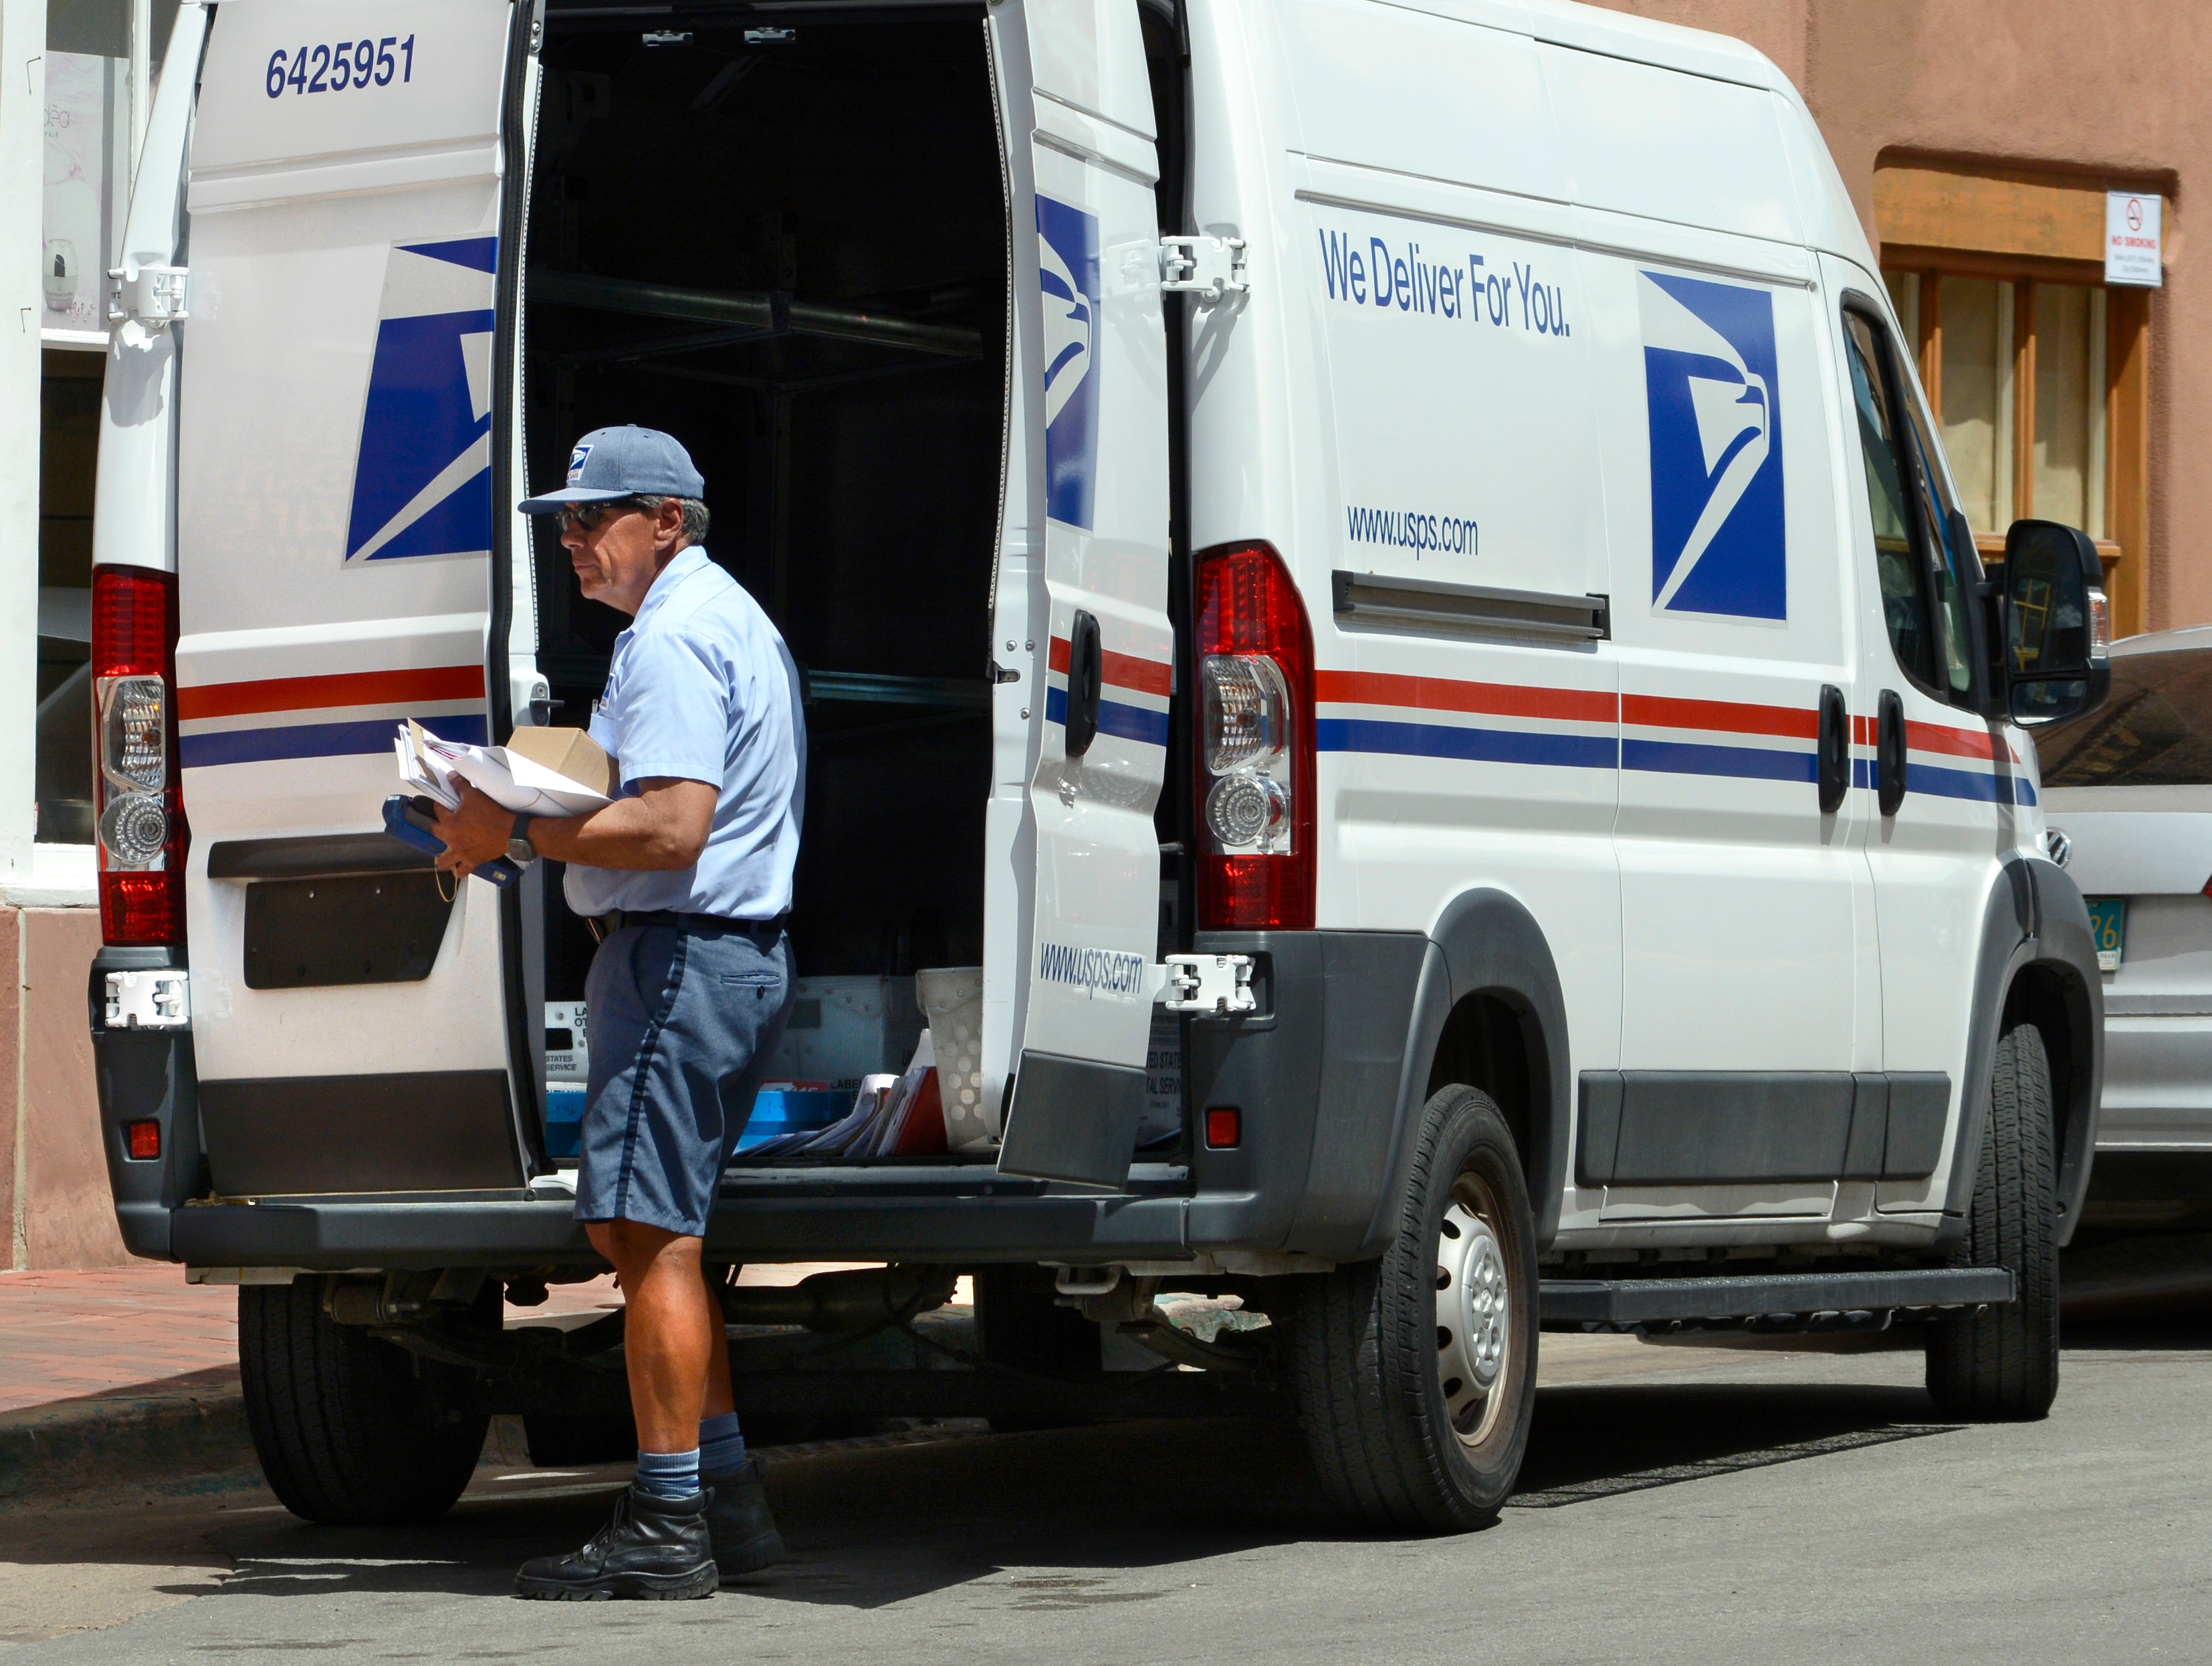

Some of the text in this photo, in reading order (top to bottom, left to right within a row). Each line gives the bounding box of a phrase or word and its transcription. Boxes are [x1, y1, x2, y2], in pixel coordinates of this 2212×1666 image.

[266, 33, 415, 99] 6425951
[2112, 235, 2156, 249] NO SMOKING
[1319, 228, 1571, 337] We Deliver For You.
[1347, 505, 1478, 561] www.usps.com
[1040, 942, 1143, 1000] www.usps.com
